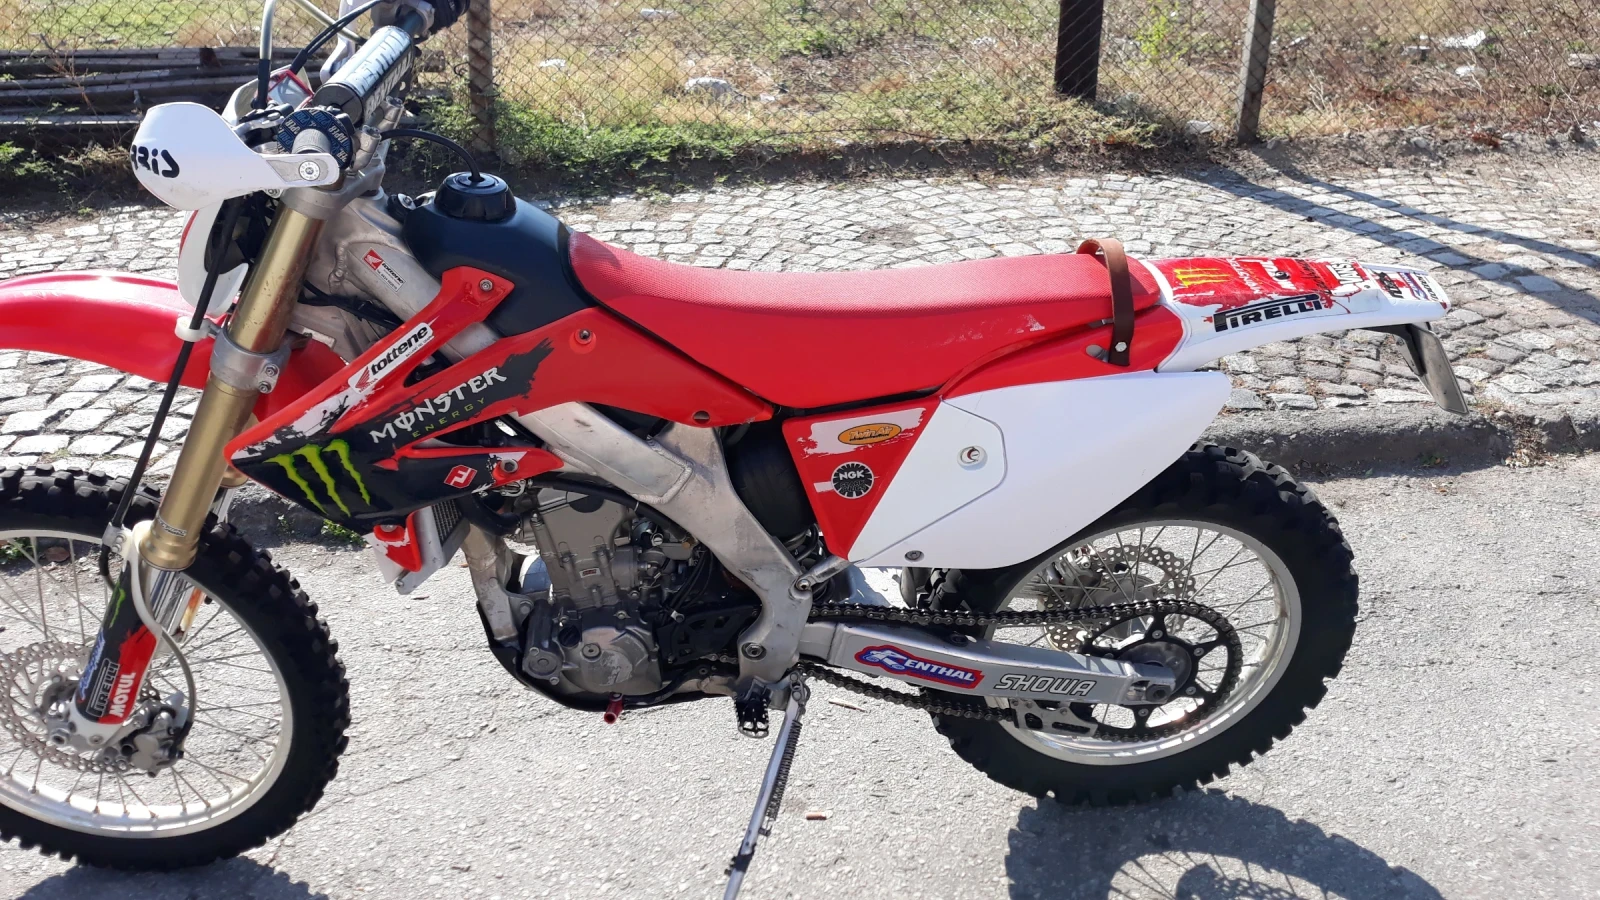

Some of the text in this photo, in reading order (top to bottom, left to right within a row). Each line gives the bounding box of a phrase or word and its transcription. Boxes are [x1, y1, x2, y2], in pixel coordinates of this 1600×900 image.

[1213, 293, 1323, 333] PIRELLI
[371, 326, 428, 376] tottene
[369, 367, 507, 444] MONSTER
[412, 397, 485, 438] ENERGY
[839, 470, 865, 481] NGK
[86, 658, 120, 718] PIRELLI
[109, 672, 137, 718] MOTUL
[994, 673, 1098, 697] SHOWA
